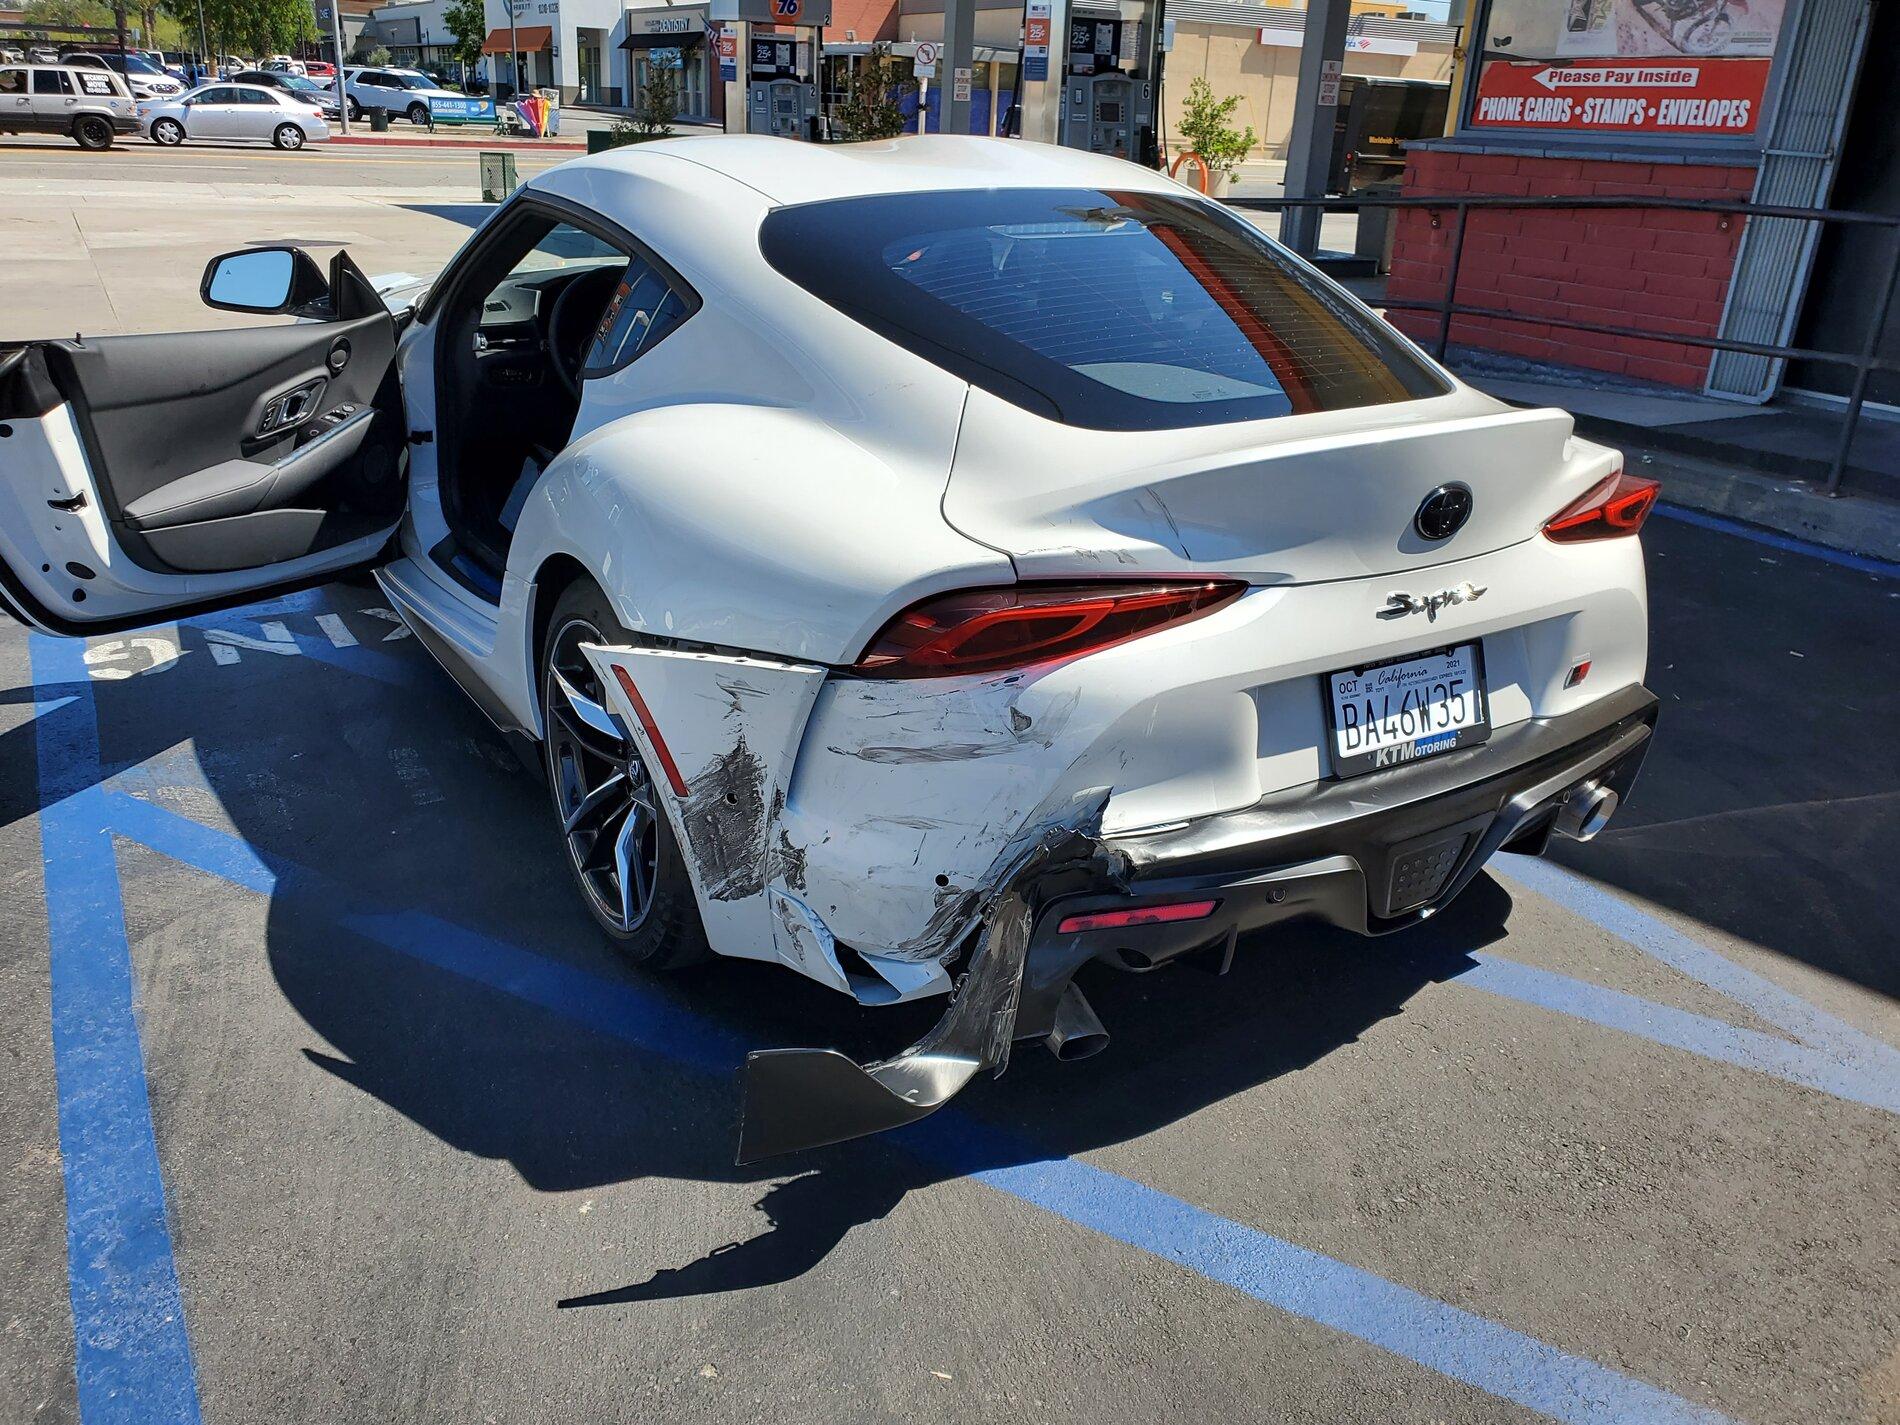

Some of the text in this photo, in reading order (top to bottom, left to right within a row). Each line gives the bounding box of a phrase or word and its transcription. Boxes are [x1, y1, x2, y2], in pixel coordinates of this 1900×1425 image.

[776, 0, 799, 16] 76
[824, 15, 830, 25] 2
[1072, 32, 1091, 44] 25¢
[1548, 70, 1693, 84] Please Pay Inside
[810, 86, 816, 97] 2
[1143, 83, 1149, 99] 6
[1479, 97, 1751, 128] PHONE CARDS STAMPS ENVELOPES
[1377, 667, 1428, 688] California
[1446, 660, 1460, 669] 2021
[1339, 680, 1358, 694] OCT
[1341, 679, 1466, 751] BA46W35
